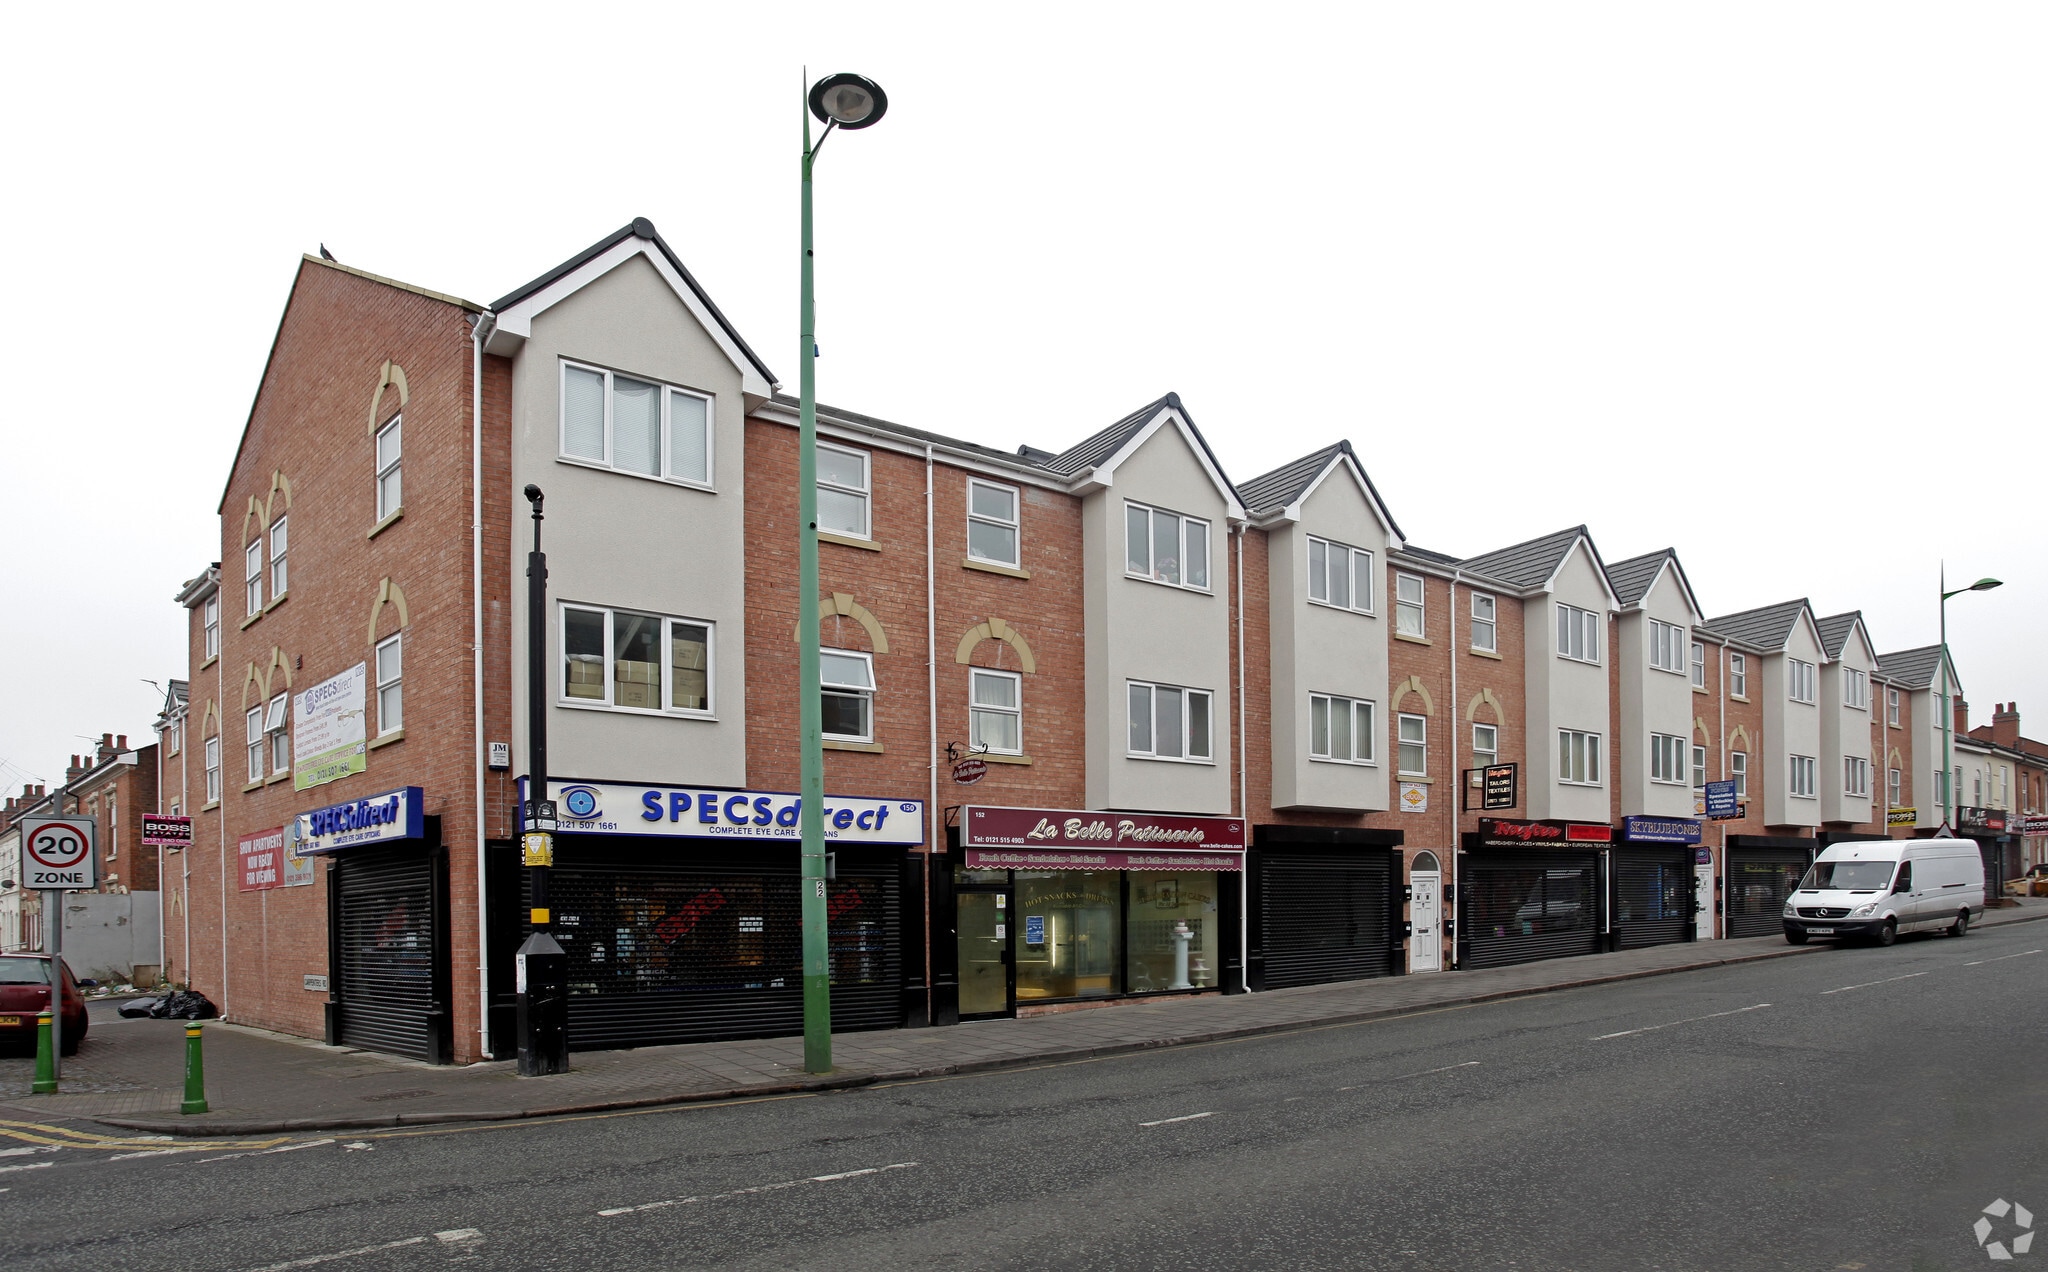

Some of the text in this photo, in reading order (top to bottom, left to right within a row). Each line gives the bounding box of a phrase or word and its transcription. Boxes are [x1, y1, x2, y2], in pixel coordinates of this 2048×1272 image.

[314, 677, 352, 704] SPECSdirect
[492, 743, 507, 752] JM
[1488, 786, 1511, 794] TEXTILES
[641, 790, 889, 831] SPECSdrect
[902, 804, 915, 812] 150
[309, 795, 400, 837] SPECSdirect
[145, 823, 190, 832] BOSS
[579, 821, 595, 829] 507
[599, 821, 617, 830] 1661
[709, 826, 752, 835] COMPLETE
[755, 827, 771, 836] EYE
[775, 828, 796, 837] CARE
[1026, 817, 1205, 843] La Belle Patisserie
[38, 836, 78, 855] 20
[240, 833, 283, 855] SHOW APARTMENTS
[973, 835, 985, 843] Tel:
[247, 855, 258, 870] NOW
[258, 852, 273, 868] READY
[978, 853, 1000, 862] Fresh
[1000, 853, 1023, 863] Coffee
[34, 872, 84, 884] ZONE
[246, 868, 276, 885] FOR VIEWING
[1025, 896, 1042, 908] HOT
[1044, 891, 1077, 902] SNACKS
